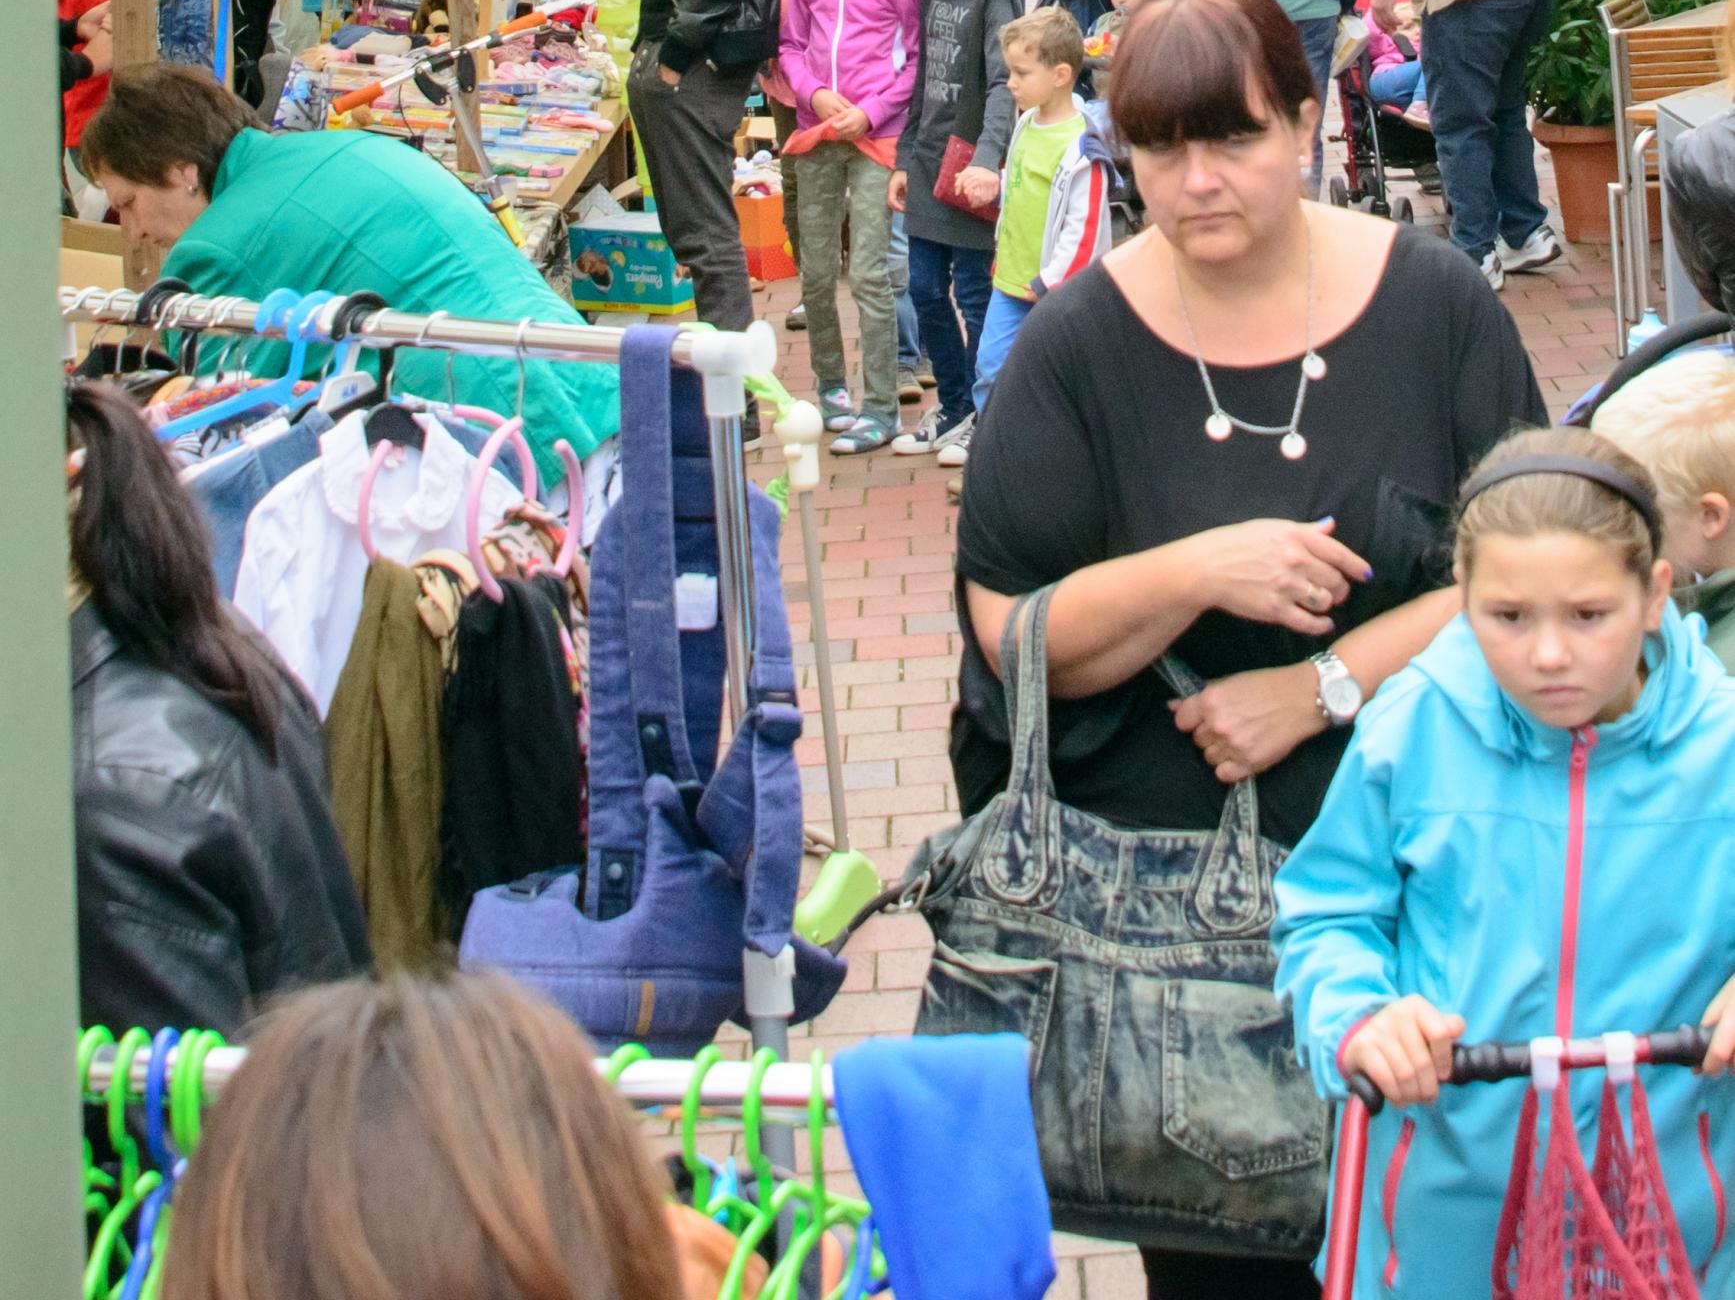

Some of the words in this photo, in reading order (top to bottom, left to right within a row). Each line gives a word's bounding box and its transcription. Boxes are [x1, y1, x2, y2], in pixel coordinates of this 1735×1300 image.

[929, 0, 970, 24] TODAY
[933, 20, 959, 44] FEEL
[625, 273, 664, 290] Pampers
